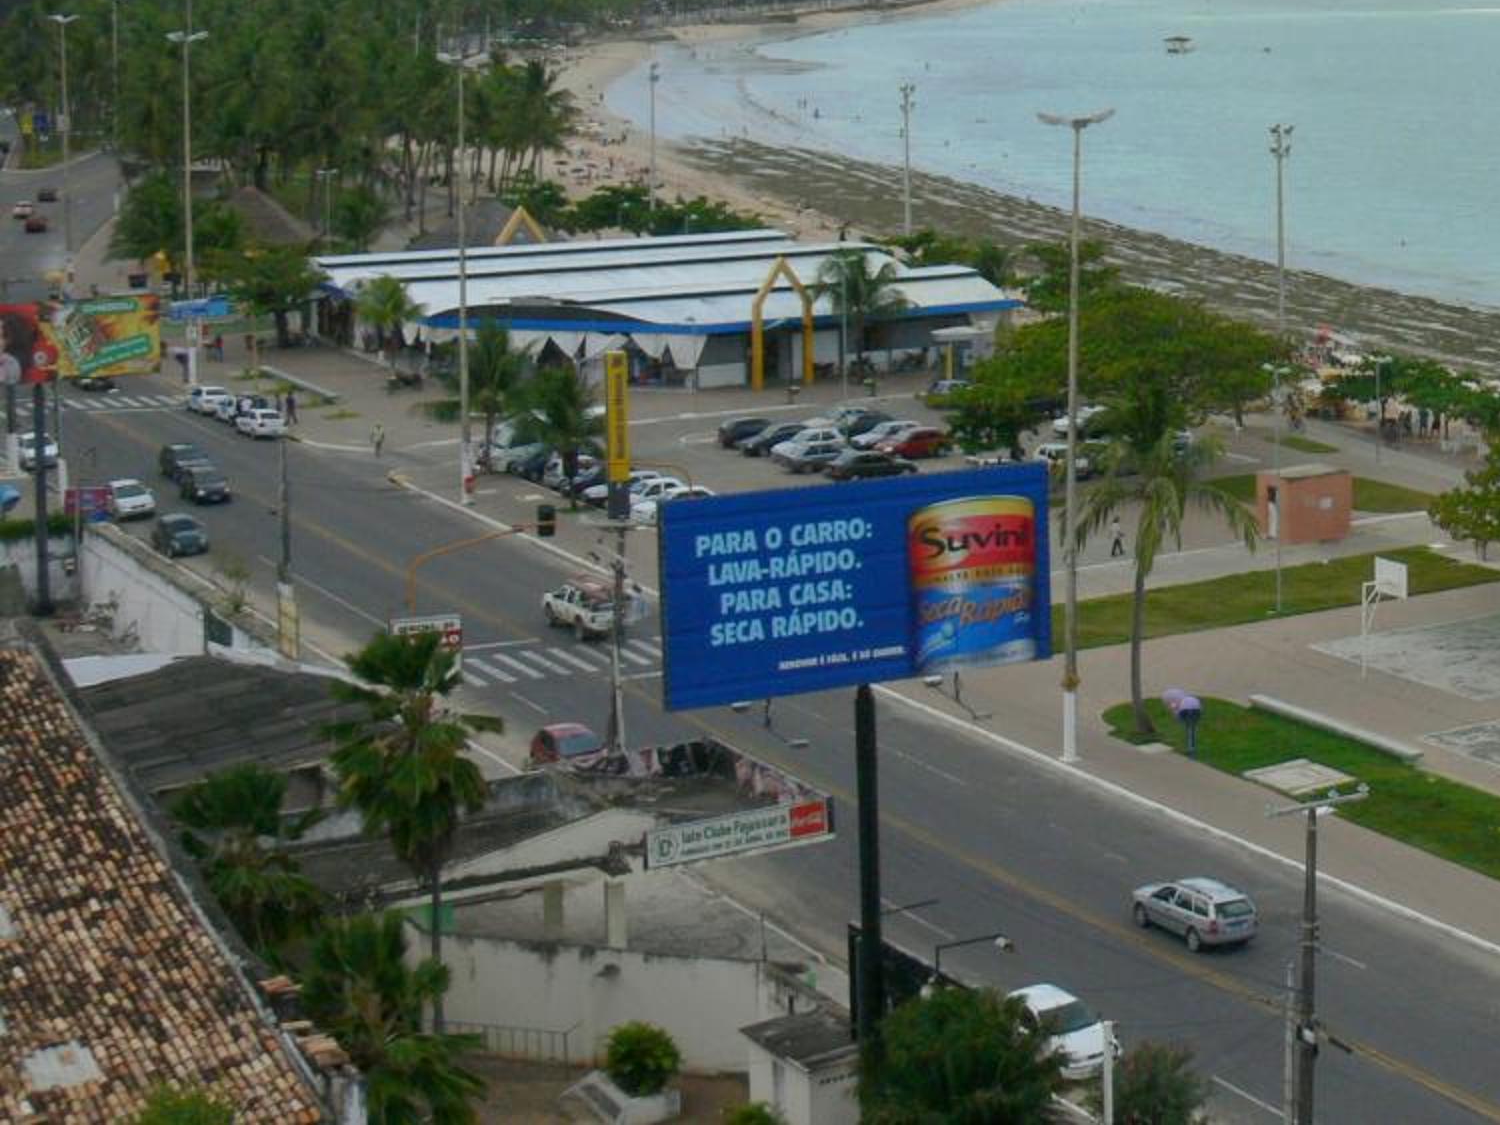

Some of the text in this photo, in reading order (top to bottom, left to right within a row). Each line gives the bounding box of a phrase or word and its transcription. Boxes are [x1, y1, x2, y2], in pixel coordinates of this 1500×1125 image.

[696, 517, 873, 558] PARA O CARRO:
[708, 548, 863, 586] LAVA-RÁPIDO.
[720, 579, 854, 615] PARA CASA:
[710, 607, 865, 647] SECA RÁPIDO.
